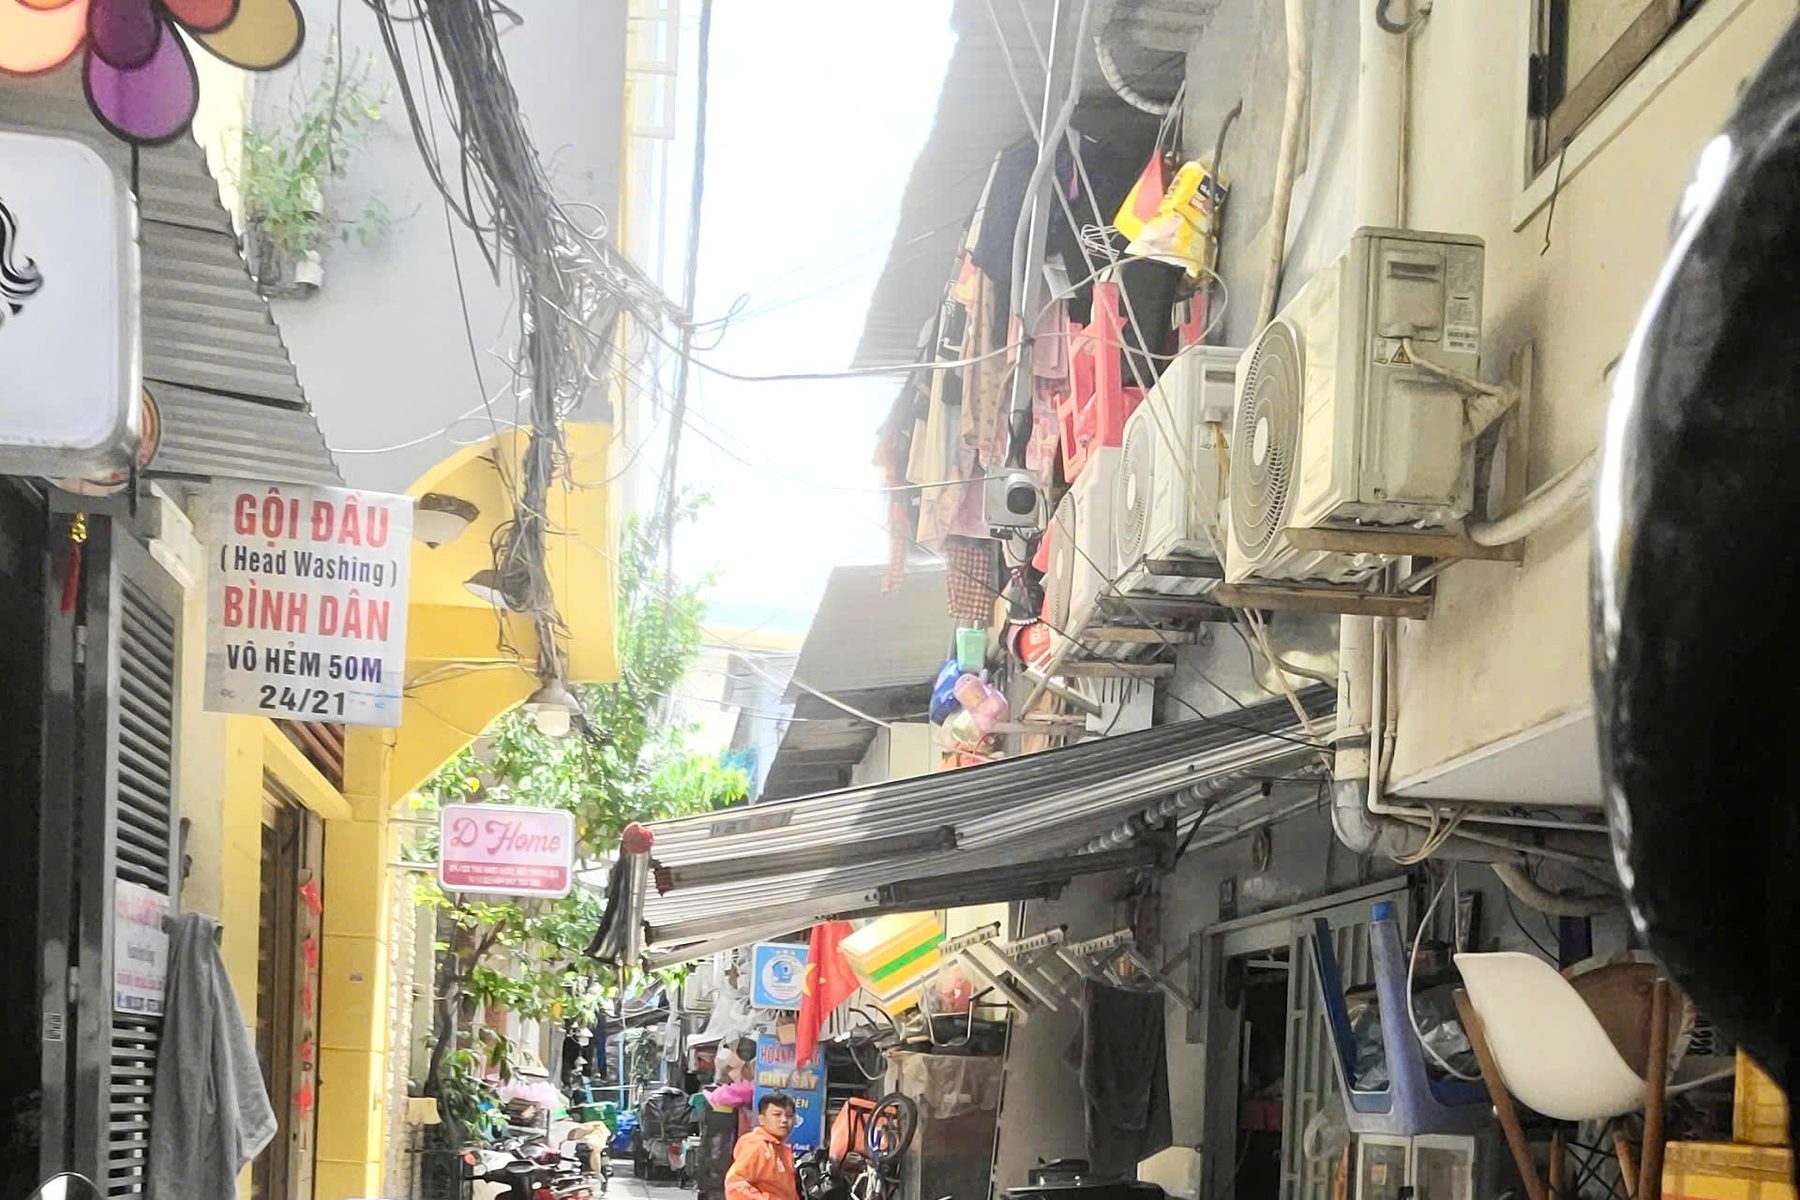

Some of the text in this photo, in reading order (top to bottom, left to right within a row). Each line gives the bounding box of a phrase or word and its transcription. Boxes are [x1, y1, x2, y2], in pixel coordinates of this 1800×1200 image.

[234, 487, 390, 548] GỘI ĐẦU
[223, 579, 390, 642] BÌNH DÂN
[227, 641, 382, 683] VÔ HẺM 50M
[258, 684, 345, 716] 24/21
[485, 820, 561, 855] Home
